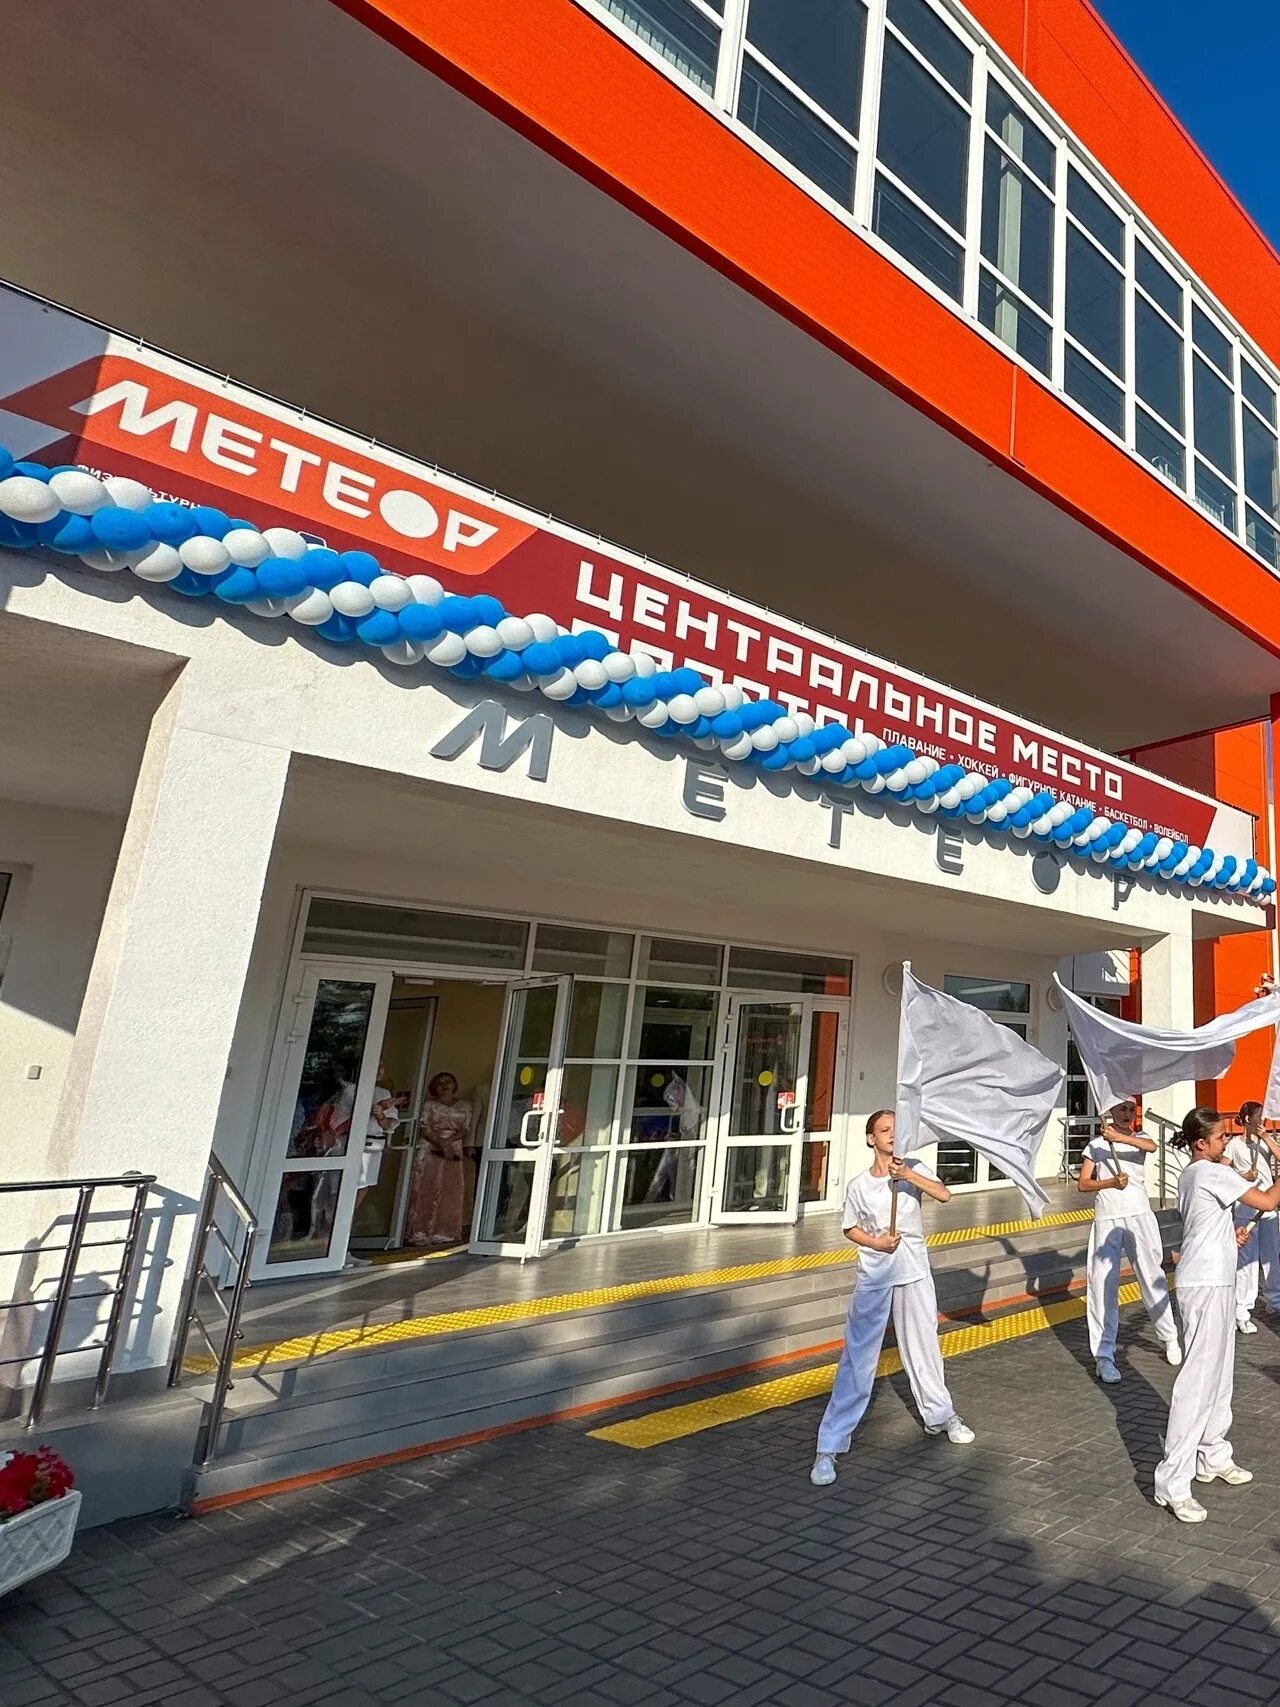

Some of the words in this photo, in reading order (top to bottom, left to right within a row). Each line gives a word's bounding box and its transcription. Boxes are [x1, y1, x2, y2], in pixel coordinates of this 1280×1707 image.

[68, 379, 499, 553] МЕТЕОР
[575, 560, 997, 755] ЦЕНТРАЛЬНОЕ
[1012, 733, 1124, 801] МЕСТО
[882, 727, 947, 762] ПЛАВАНИЕ
[957, 753, 999, 778] ХОККЕЙ
[1059, 789, 1097, 813] КАТАНИЕ
[1104, 805, 1148, 831] БАСКЕТБОЛ
[1153, 822, 1189, 844] ВОЛЕЙБОЛ
